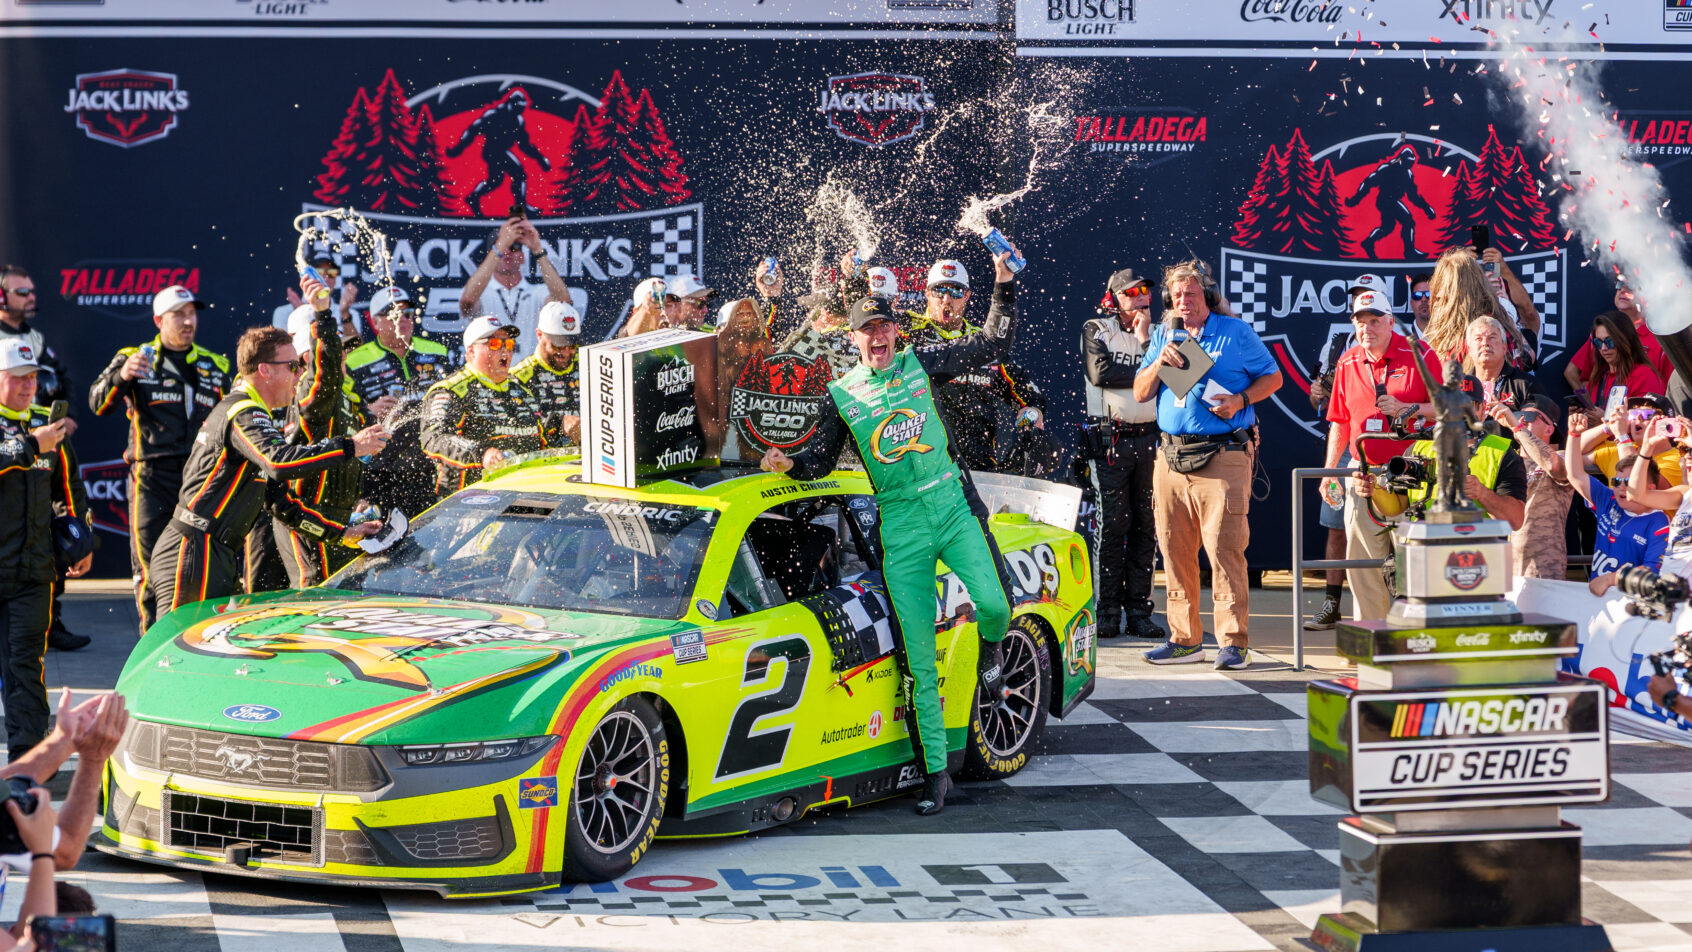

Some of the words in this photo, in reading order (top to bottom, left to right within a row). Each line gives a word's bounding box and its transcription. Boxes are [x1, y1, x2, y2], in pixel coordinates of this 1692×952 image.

[255, 3, 307, 15] LIGHT
[1047, 0, 1134, 21] BUSCH
[1066, 23, 1117, 35] LIGHT
[64, 88, 121, 112] JACK
[122, 88, 189, 112] LINK'S
[817, 90, 872, 112] JACK
[872, 89, 936, 112] LINK'S
[1074, 116, 1207, 142] TALLADEGA
[1091, 142, 1195, 152] SUPERSPEEDWAY
[59, 267, 200, 296] TALLADEGA
[77, 295, 153, 306] SUPERSPEE
[1271, 275, 1353, 318] JAC
[599, 354, 614, 419] SERIES
[656, 364, 695, 391] BUSCH
[664, 384, 687, 396] LIGHT
[746, 396, 780, 413] JACK
[780, 398, 819, 416] LINK'S
[760, 413, 806, 429] 500
[882, 412, 927, 439] QUAKER
[602, 422, 616, 457] CUP
[891, 423, 923, 445] STATE
[656, 444, 698, 471] xfinity
[760, 484, 798, 499] AUSTIN
[800, 480, 840, 492] CINDRIC
[583, 502, 683, 522] CINDRIC
[1443, 604, 1491, 613] WINNER
[1019, 616, 1046, 647] EAGLE
[1509, 629, 1548, 644] xfinity
[600, 660, 664, 693] GOODYEAR
[233, 706, 271, 721] Ford
[711, 633, 813, 784] 2
[1434, 697, 1569, 737] NASCAR
[821, 722, 867, 746] Autotrader
[1390, 753, 1455, 784] CUP
[1459, 747, 1571, 781] SERIES
[521, 787, 556, 800] SUNOCO
[510, 908, 863, 929] VICTORY
[892, 904, 1102, 921] LANE
